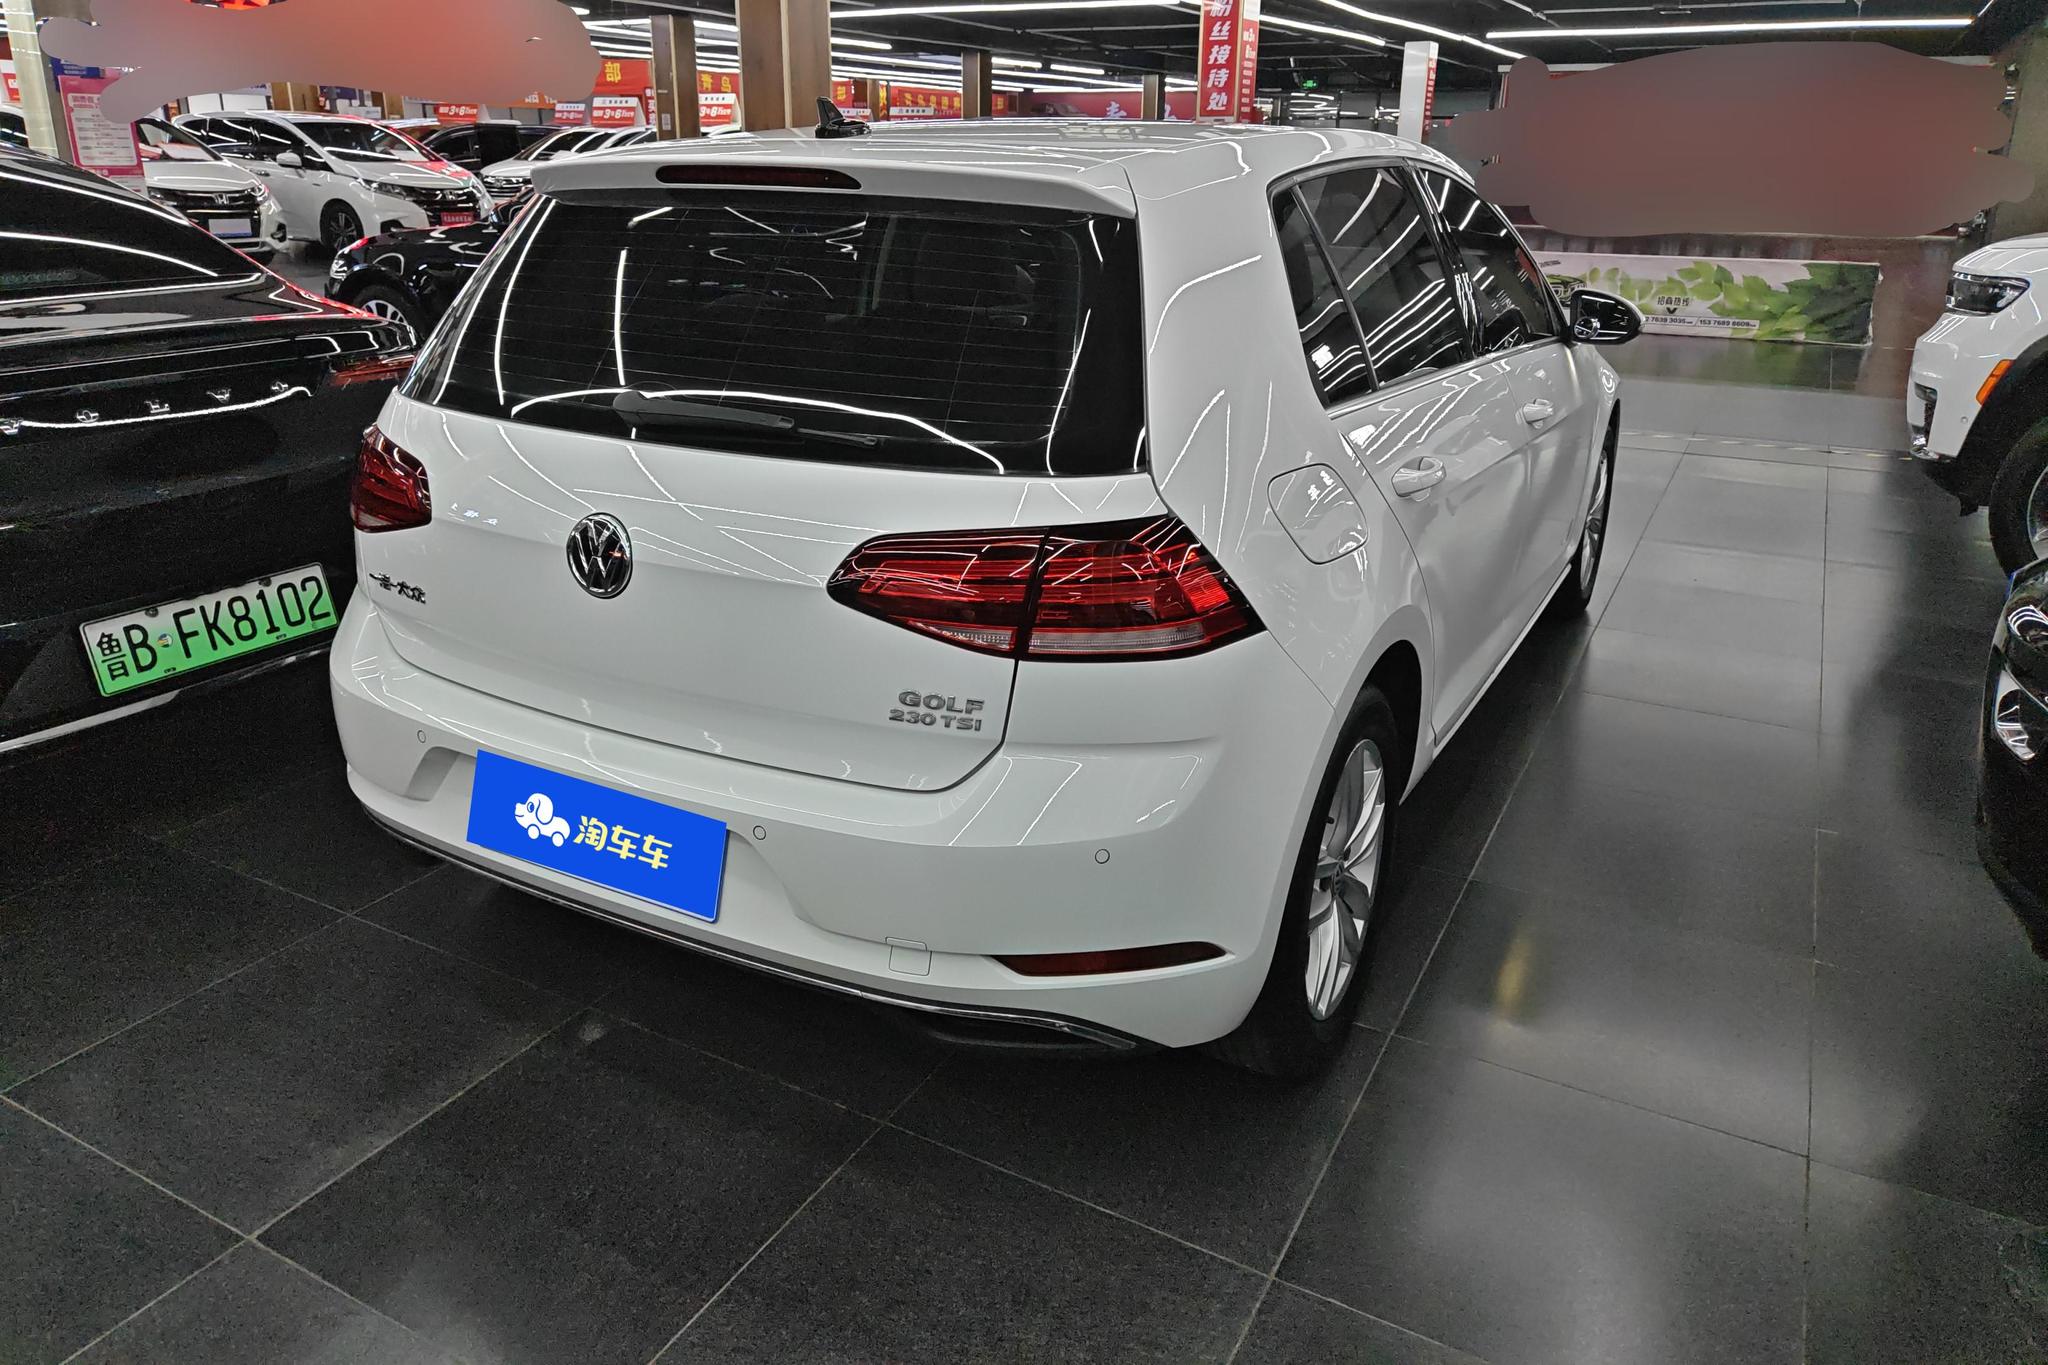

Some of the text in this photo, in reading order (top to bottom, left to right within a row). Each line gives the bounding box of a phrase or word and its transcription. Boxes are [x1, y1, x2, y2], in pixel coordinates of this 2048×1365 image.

[603, 62, 623, 83] 部
[898, 691, 984, 714] GOLF
[888, 708, 982, 731] 230 TSI
